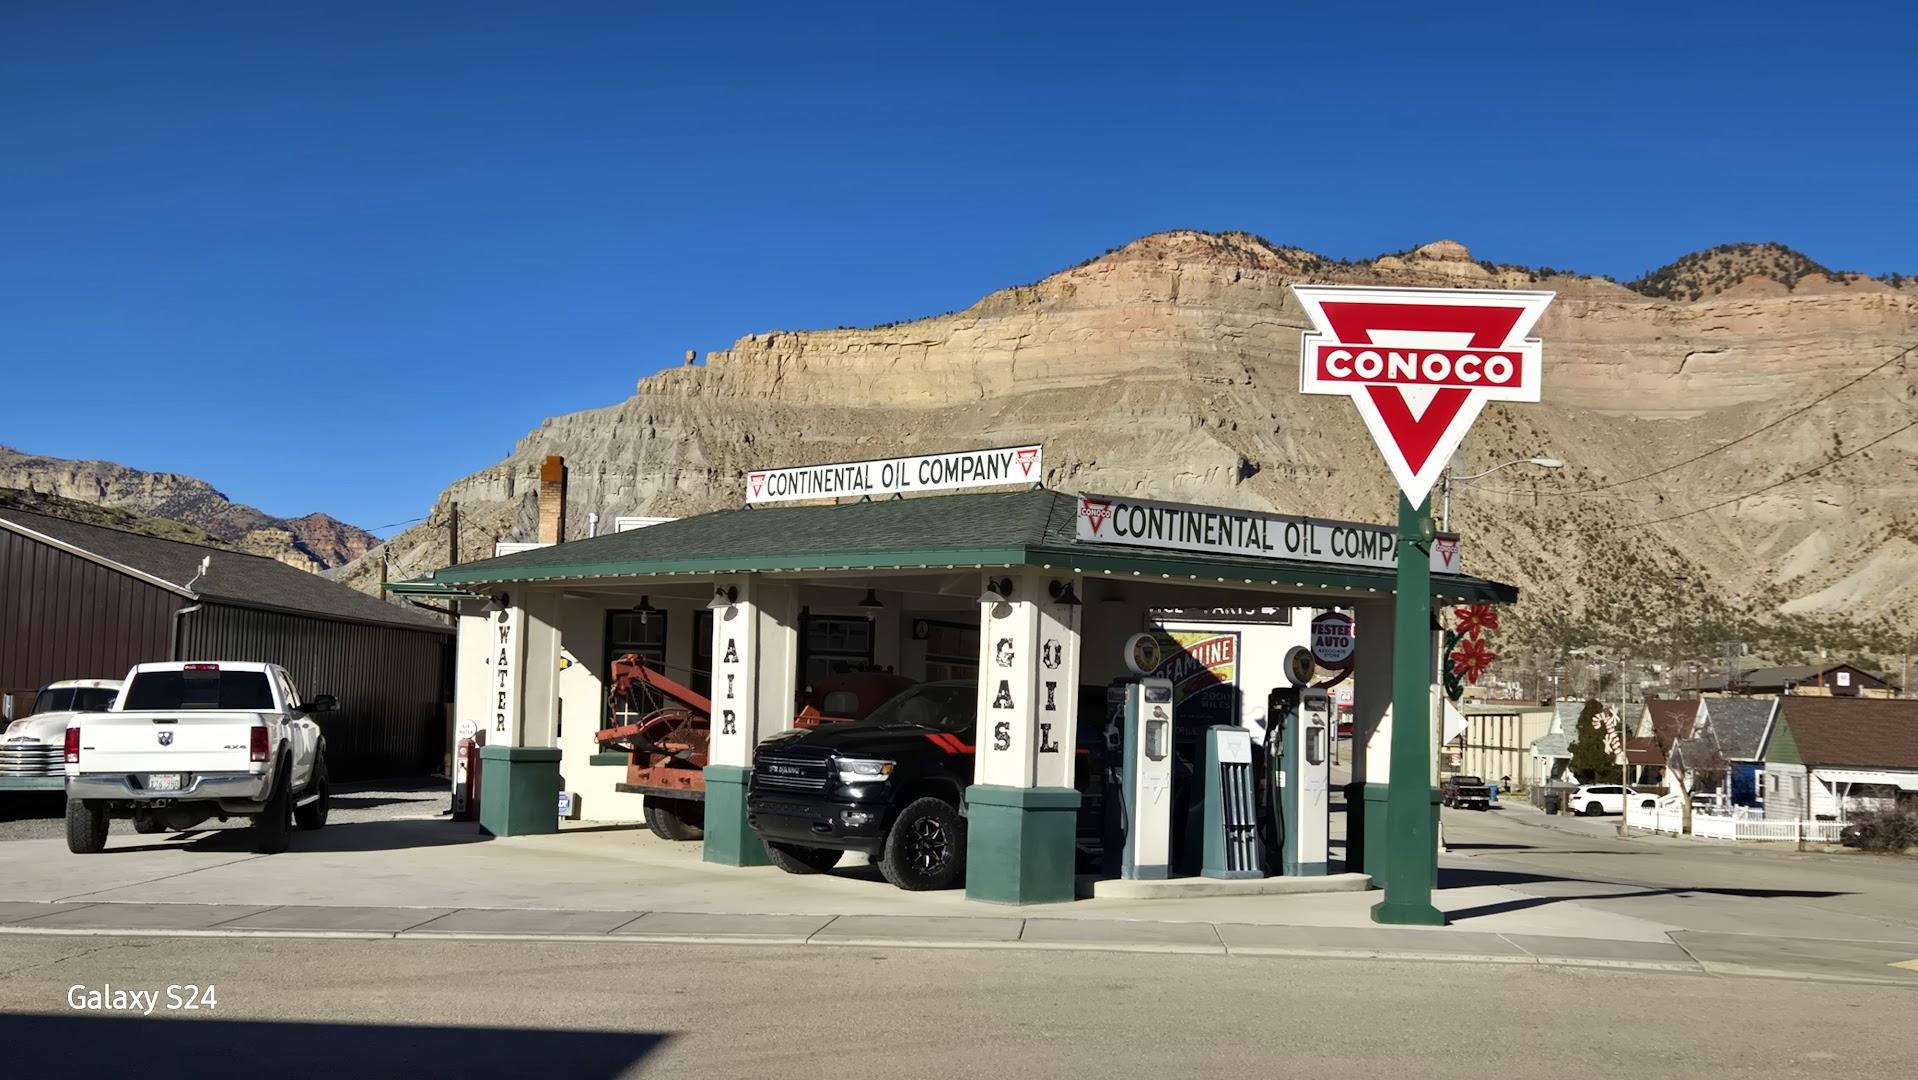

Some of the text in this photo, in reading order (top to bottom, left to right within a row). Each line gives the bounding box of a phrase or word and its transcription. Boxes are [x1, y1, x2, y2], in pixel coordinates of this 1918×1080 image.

[1325, 349, 1514, 384] CONOCO
[767, 452, 1014, 497] CONTINENTAL OIL COMPANY
[1081, 508, 1111, 518] CONOCO
[1113, 503, 1274, 551] CONTINENTAL
[1285, 522, 1322, 556] OIL
[1316, 636, 1349, 648] AUTO
[496, 625, 511, 732] WATER
[722, 638, 740, 735] AIR
[993, 638, 1015, 751] GAS
[1040, 638, 1062, 753] OIL
